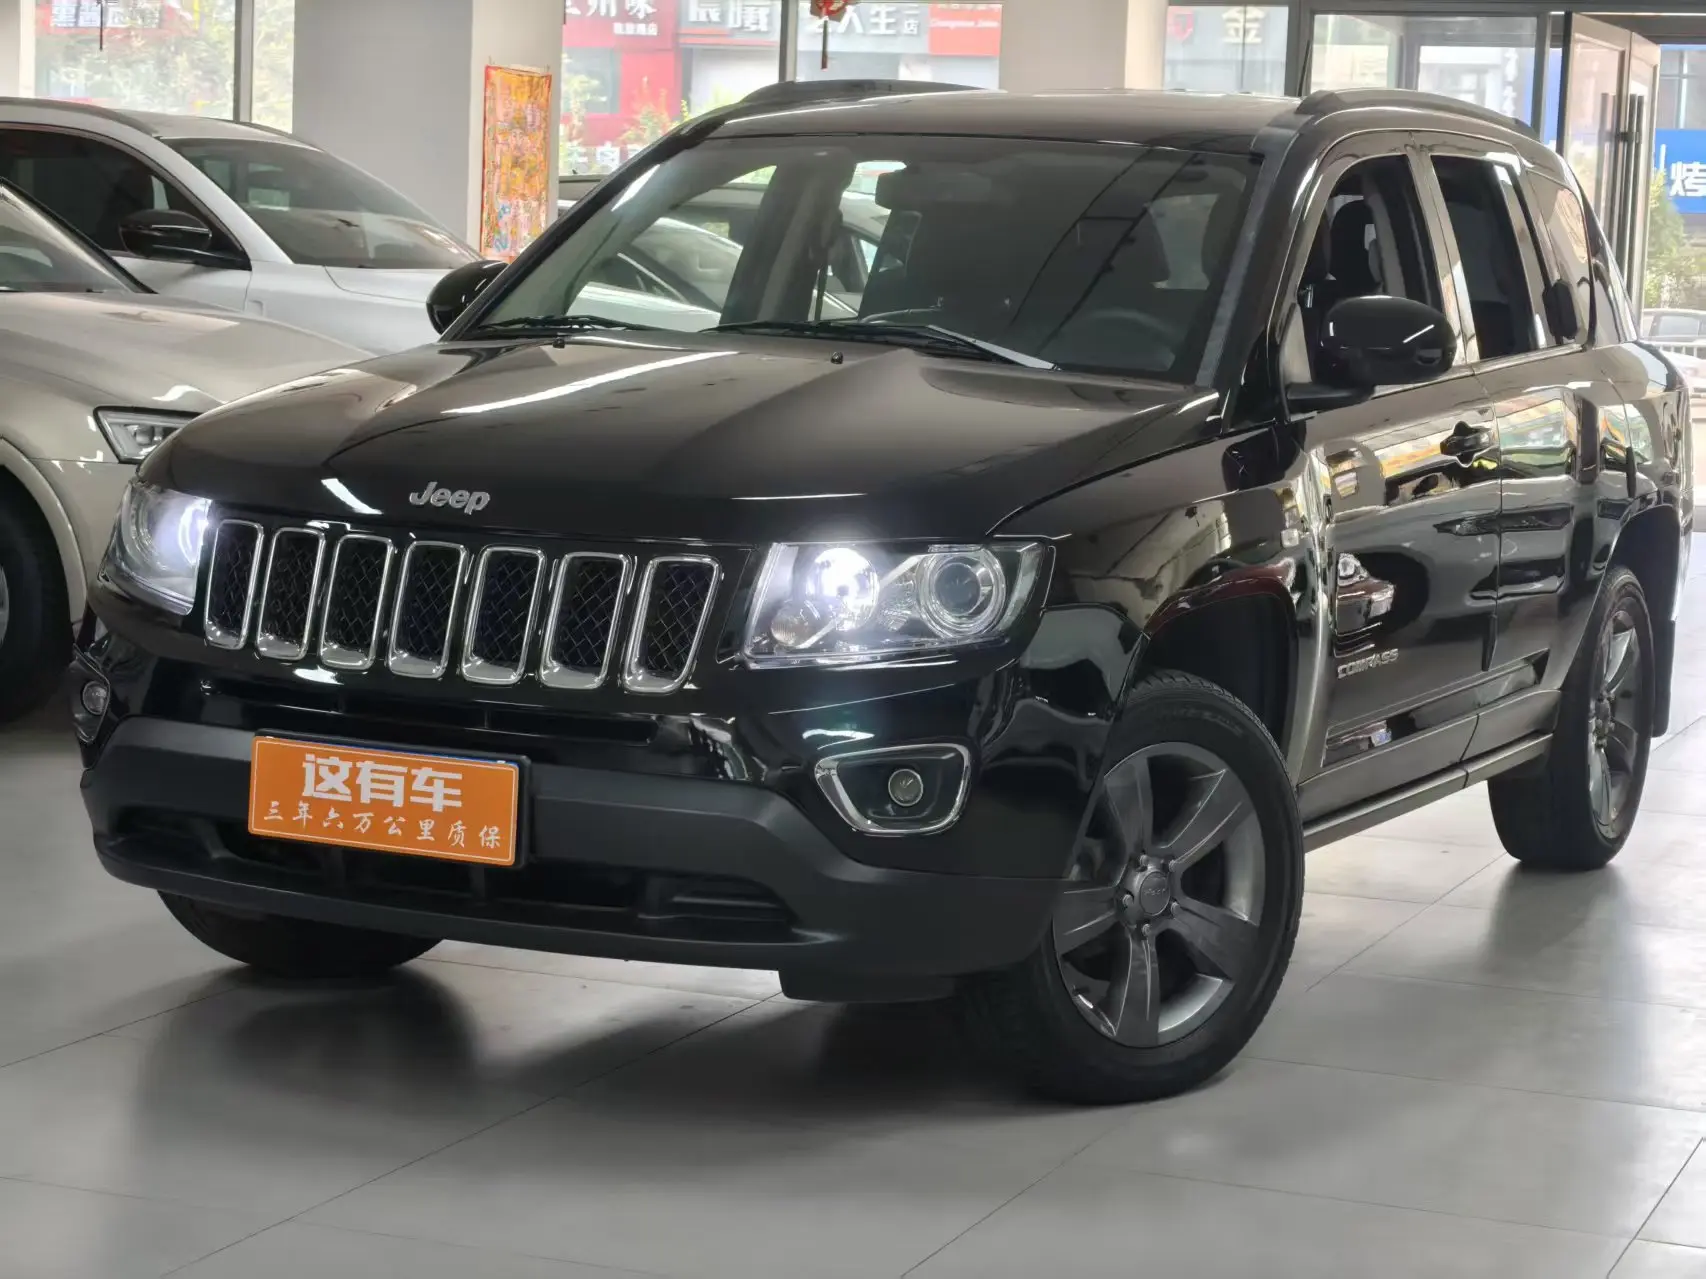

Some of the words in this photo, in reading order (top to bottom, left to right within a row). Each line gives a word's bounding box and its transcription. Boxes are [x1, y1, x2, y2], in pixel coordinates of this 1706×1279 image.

[1221, 6, 1265, 44] 金
[409, 481, 491, 515] Jeep
[1337, 648, 1399, 679] COMPASS
[302, 753, 463, 813] 这有车
[263, 800, 501, 849] 三年六万公里质保
